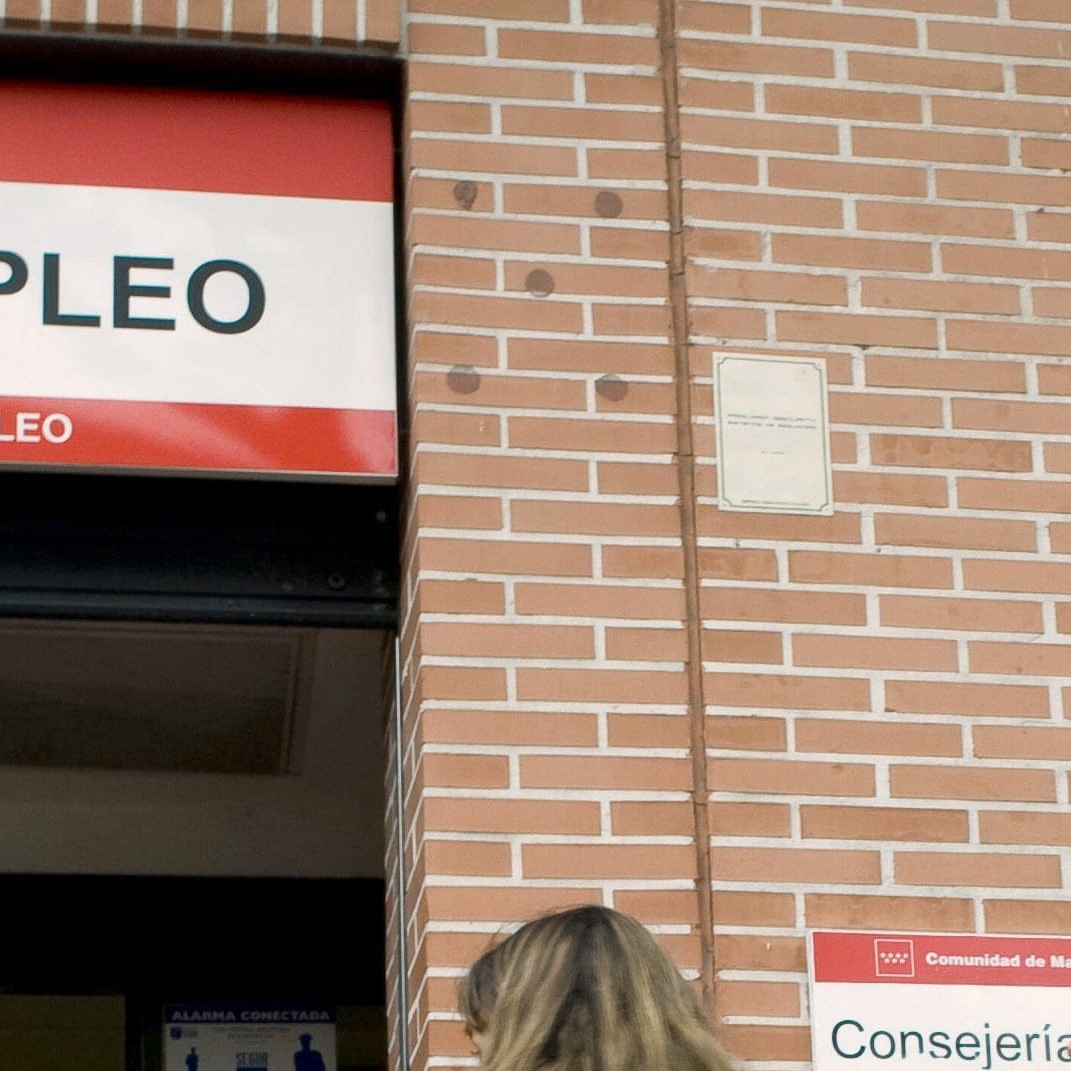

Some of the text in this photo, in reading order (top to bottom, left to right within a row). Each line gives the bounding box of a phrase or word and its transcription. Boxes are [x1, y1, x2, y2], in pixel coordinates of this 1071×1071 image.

[925, 951, 1021, 968] Comunidad
[1024, 954, 1046, 968] de
[171, 1010, 330, 1021] ALARMA CONECTADA
